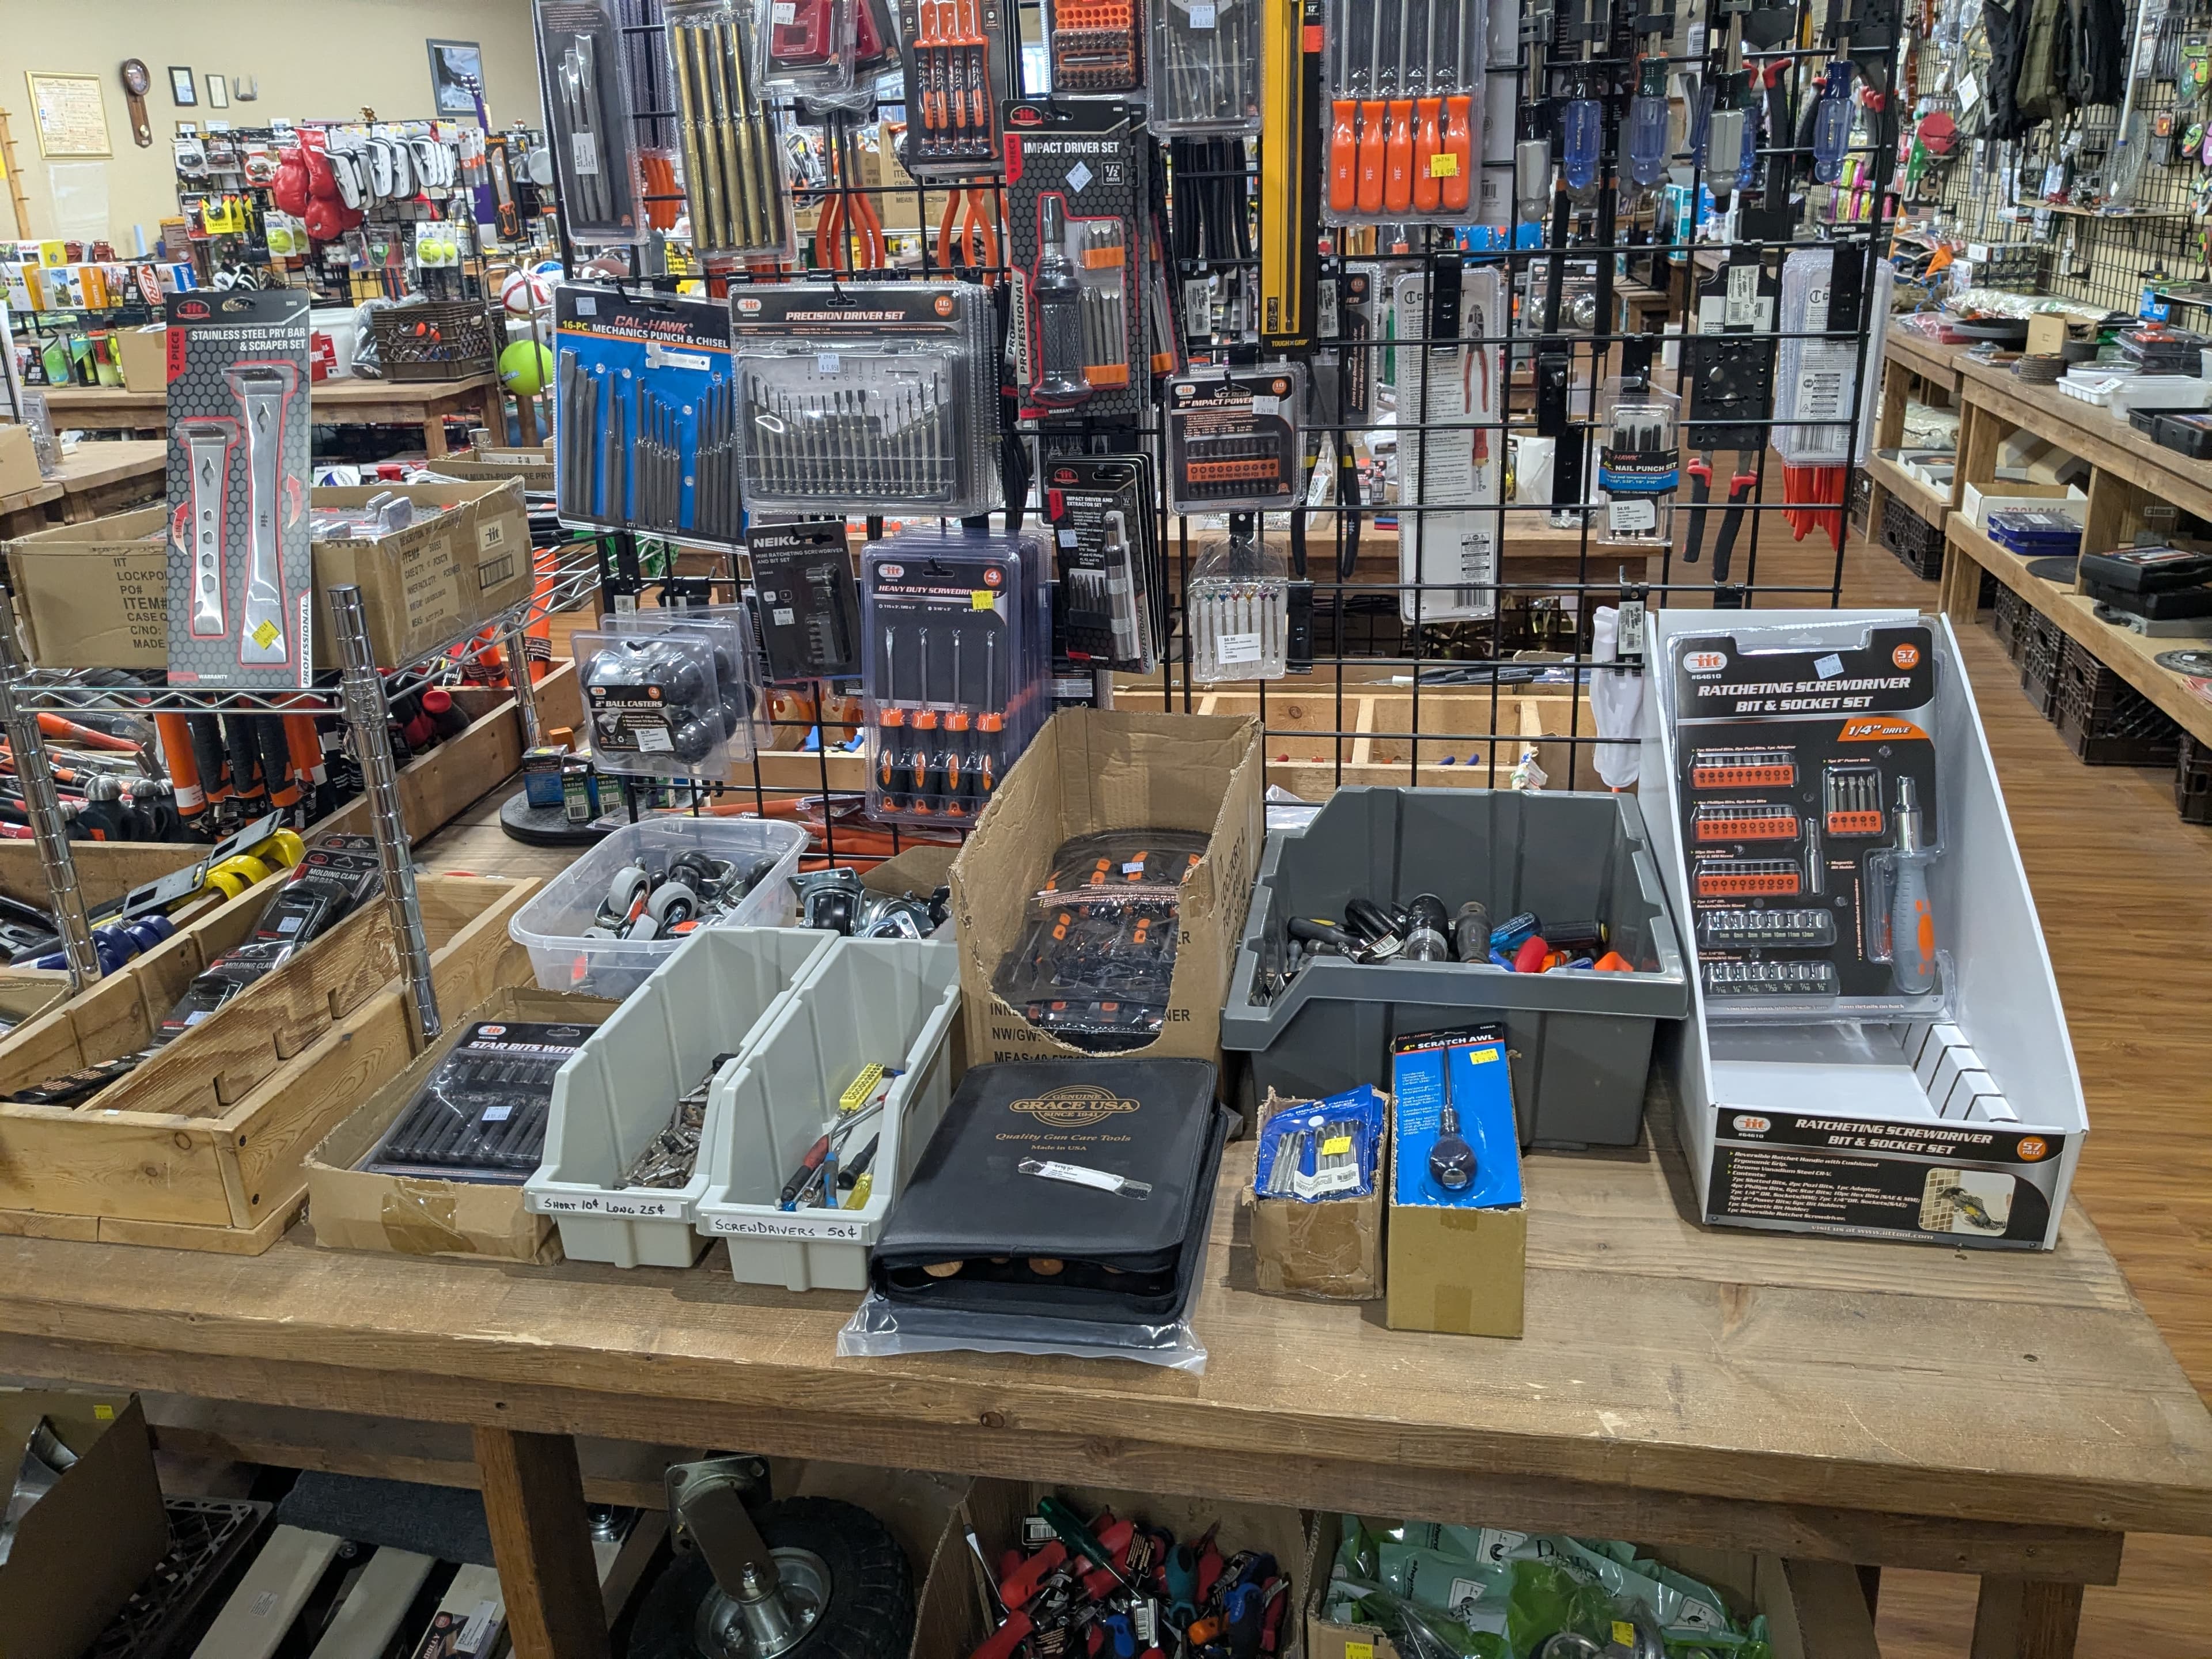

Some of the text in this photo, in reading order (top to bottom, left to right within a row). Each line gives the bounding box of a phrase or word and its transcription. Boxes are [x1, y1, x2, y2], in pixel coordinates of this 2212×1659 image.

[1024, 142, 1119, 154] IMPACT DRIVER SET
[135, 264, 163, 306] NERF
[785, 310, 906, 321] PRECISION DRIVER SET
[614, 315, 688, 334] CAL-HAWK
[1017, 278, 1028, 375] PROFESSIONAL
[192, 327, 306, 341] STAINLESS STEEL PRY BAR
[562, 320, 729, 349] 16-PC. MECHANICS PUNCH & CHISEL
[171, 331, 180, 361] PIECE
[240, 339, 306, 351] & SCRAPER SET
[1191, 399, 1224, 407] IMPACT
[1665, 461, 1677, 470] SET
[113, 558, 127, 567] IIT
[988, 571, 998, 580] 4
[120, 585, 143, 595] PO#
[123, 597, 168, 610] ITEM#
[127, 612, 157, 622] CASE
[130, 626, 162, 635] C/NO:
[1137, 604, 1149, 669] PROFESSIONAL
[132, 639, 166, 649] MADE
[1896, 650, 1916, 660] 57
[1691, 673, 1722, 681] #64610
[1698, 676, 1911, 697] RATCHETING SCREWDRIVER
[1735, 695, 1873, 713] BIT & SOCKET SET
[1847, 724, 1911, 736] 1/4" DRIVE
[308, 868, 361, 882] MOLDING CLAW
[991, 1027, 1041, 1043] NW/GW:
[467, 1040, 581, 1054] STAR BITS WITH
[1417, 1037, 1467, 1050] SCRATCH
[1469, 1034, 1495, 1042] AWL
[1013, 1101, 1134, 1111] GRACE USA
[995, 1132, 1042, 1142] Quality
[1794, 1118, 1993, 1144] RATCHETING SCREWDRIVER
[1828, 1136, 1956, 1154] BIT & SOCKET SET
[2022, 1142, 2043, 1151] 57
[1734, 1158, 1770, 1166] Ergonomic
[544, 1197, 577, 1210] SHORT
[605, 1201, 635, 1215] LONG
[639, 1203, 666, 1215] 25¢
[1740, 1202, 1772, 1210] Magnetic
[1740, 1208, 1775, 1217] Reversible
[714, 1218, 858, 1238] SCREWDRIVERS 50¢
